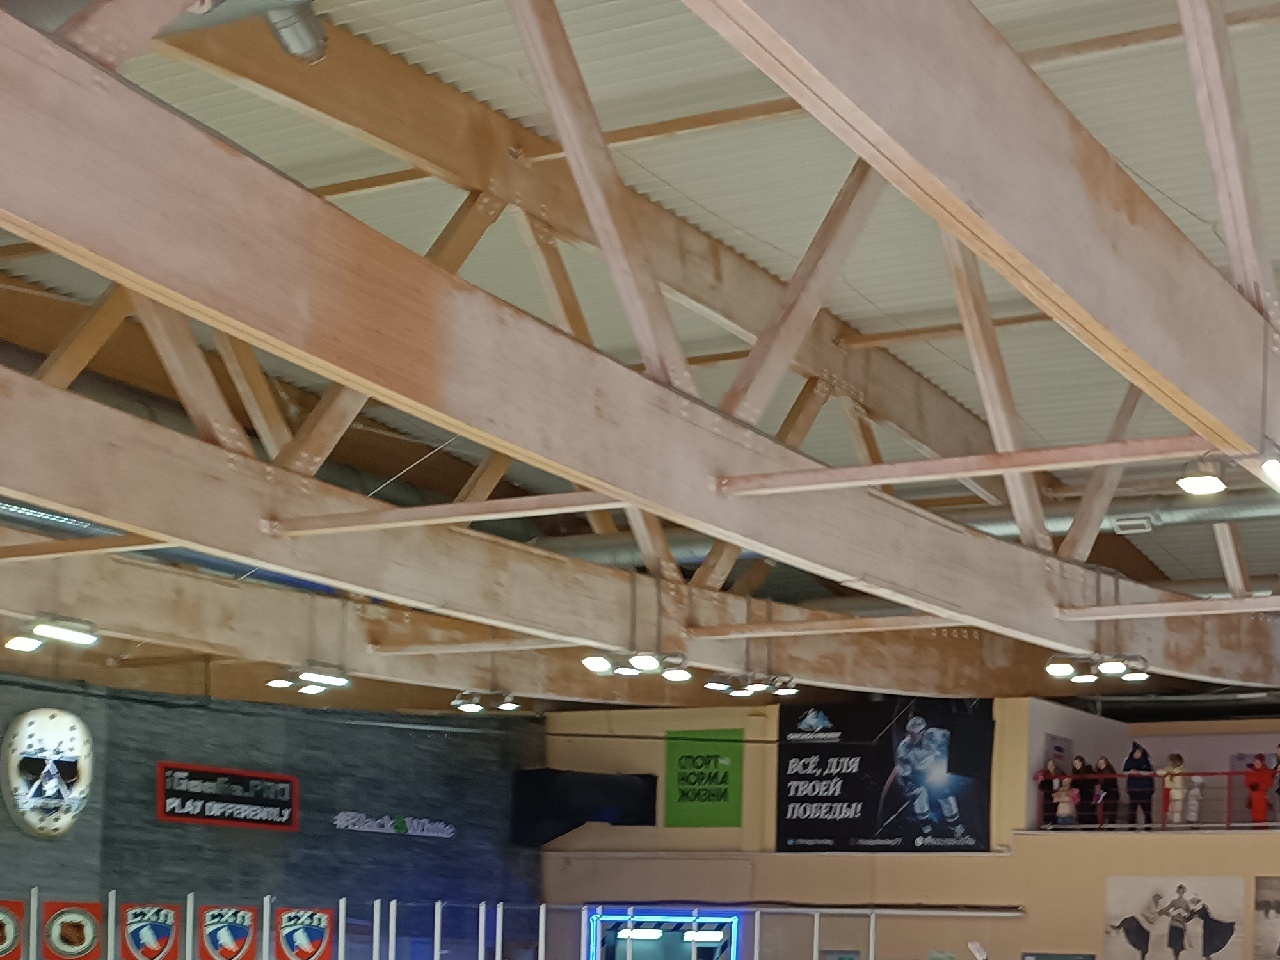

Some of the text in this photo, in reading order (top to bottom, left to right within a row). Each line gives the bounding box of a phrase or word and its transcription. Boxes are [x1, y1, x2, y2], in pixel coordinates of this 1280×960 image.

[677, 754, 720, 769] СПОРТ
[823, 755, 861, 777] ДЛЯ
[677, 771, 729, 786] НОРМА
[786, 776, 844, 797] ТВОЕЙ
[677, 787, 729, 803] ЖИЗНИ
[165, 797, 204, 815] PLAY
[784, 801, 864, 821] ПОБЕДЫ!
